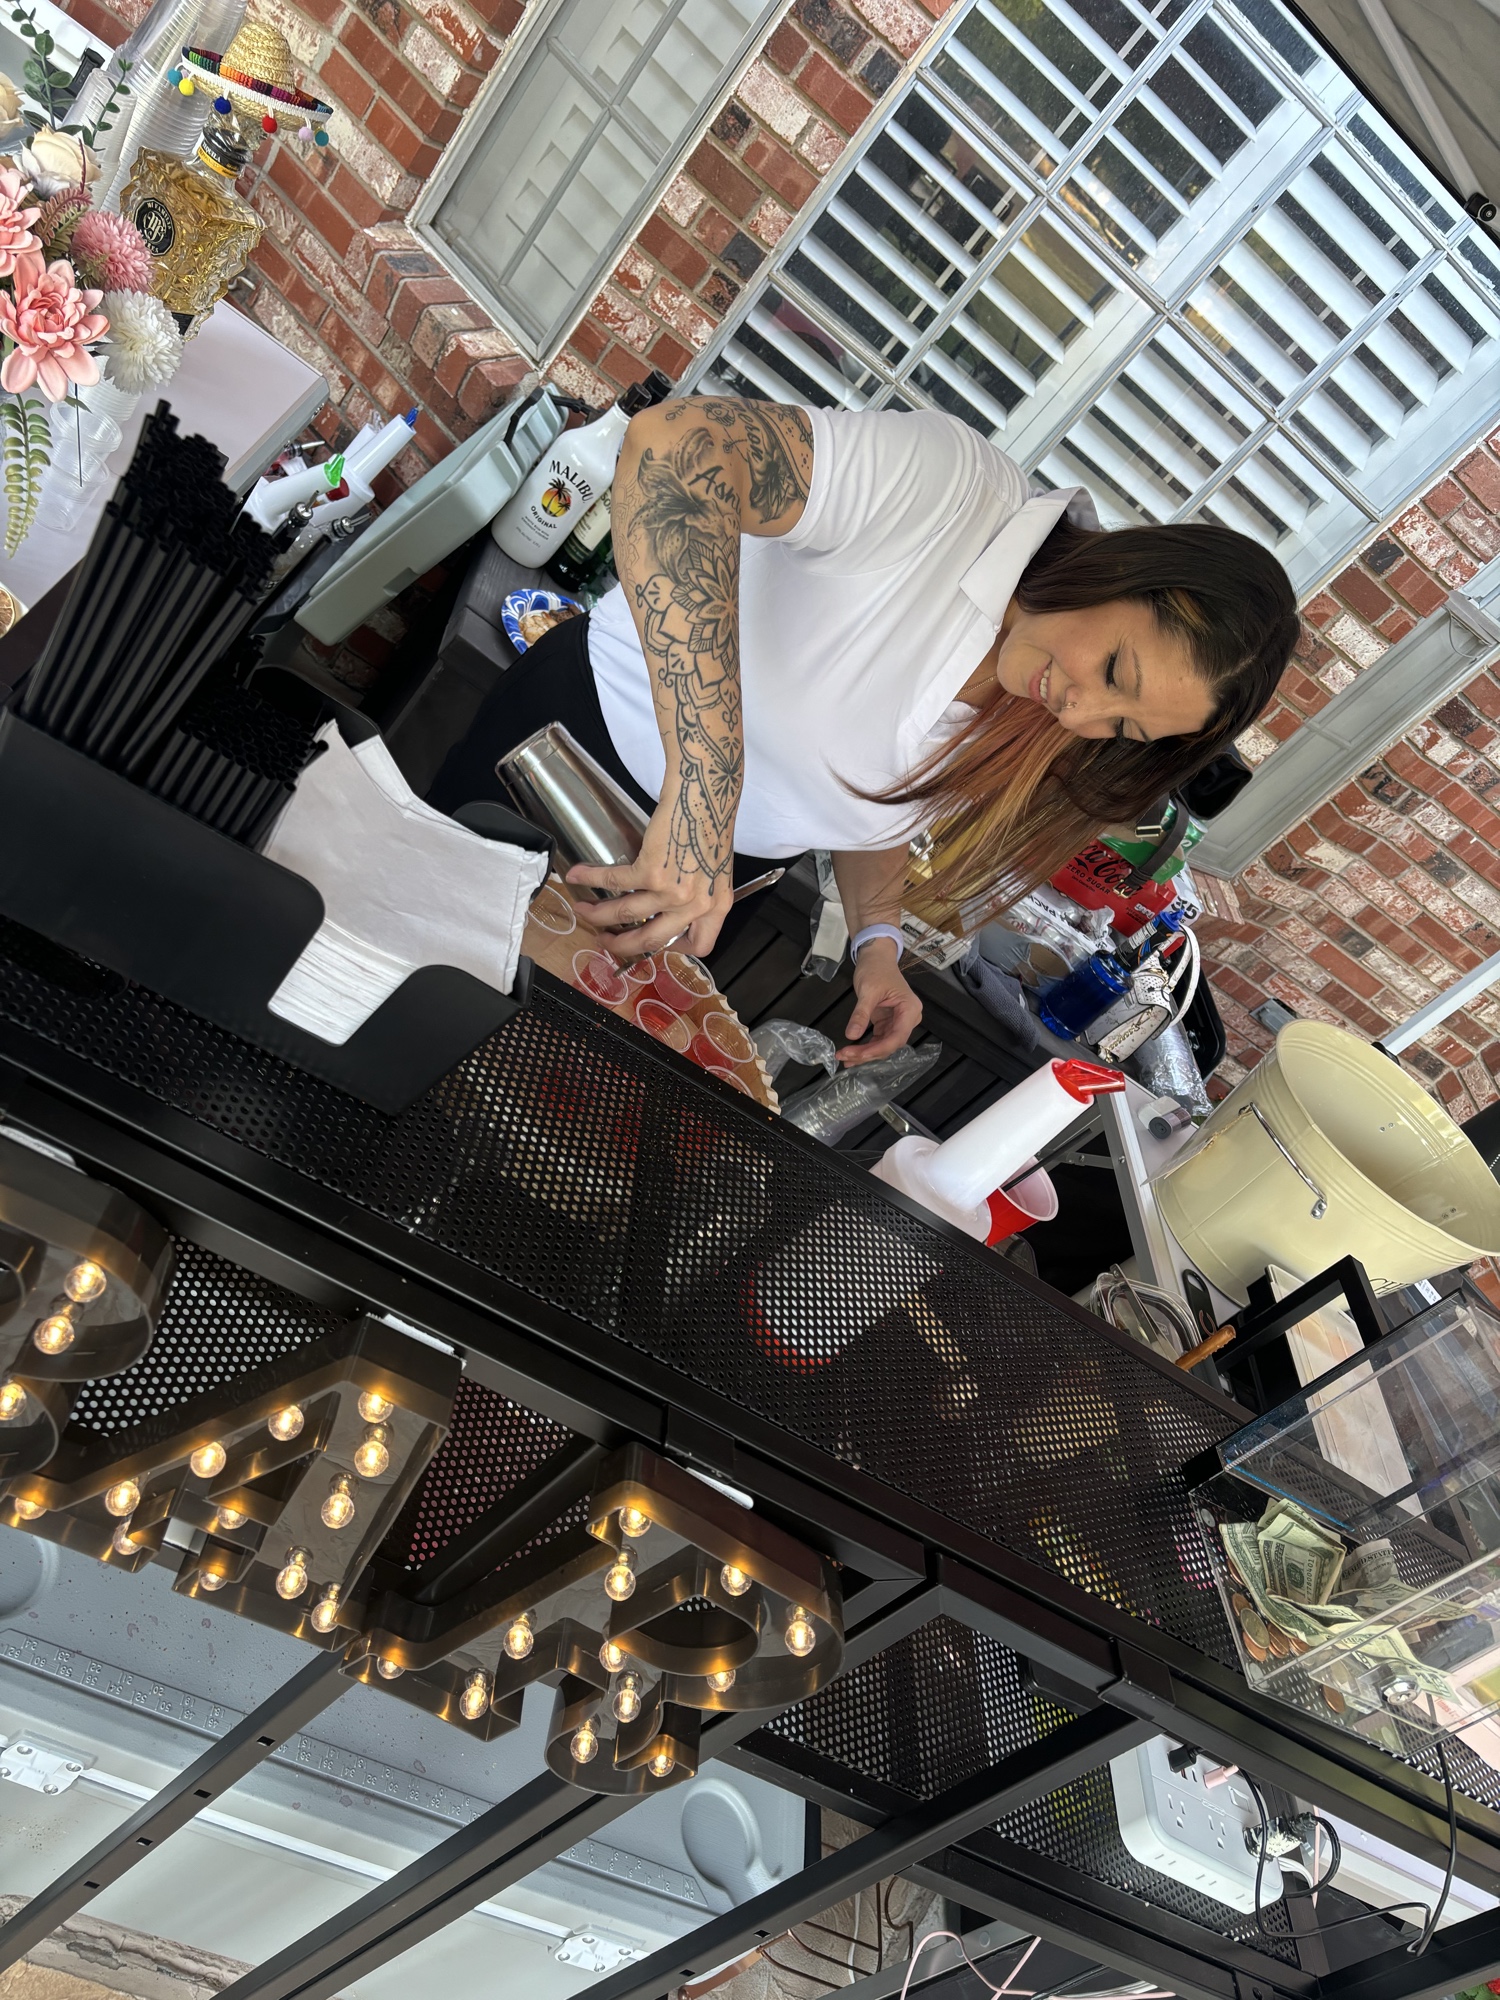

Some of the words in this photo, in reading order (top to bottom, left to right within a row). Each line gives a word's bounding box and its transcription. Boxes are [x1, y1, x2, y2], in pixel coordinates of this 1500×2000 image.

[549, 459, 594, 502] MALIBU
[530, 505, 557, 529] ORIGINAL
[1066, 863, 1085, 878] ZERO
[1086, 876, 1111, 895] SUGAR
[1171, 895, 1199, 920] 35
[134, 1691, 148, 1704] 52
[159, 1700, 172, 1712] 50
